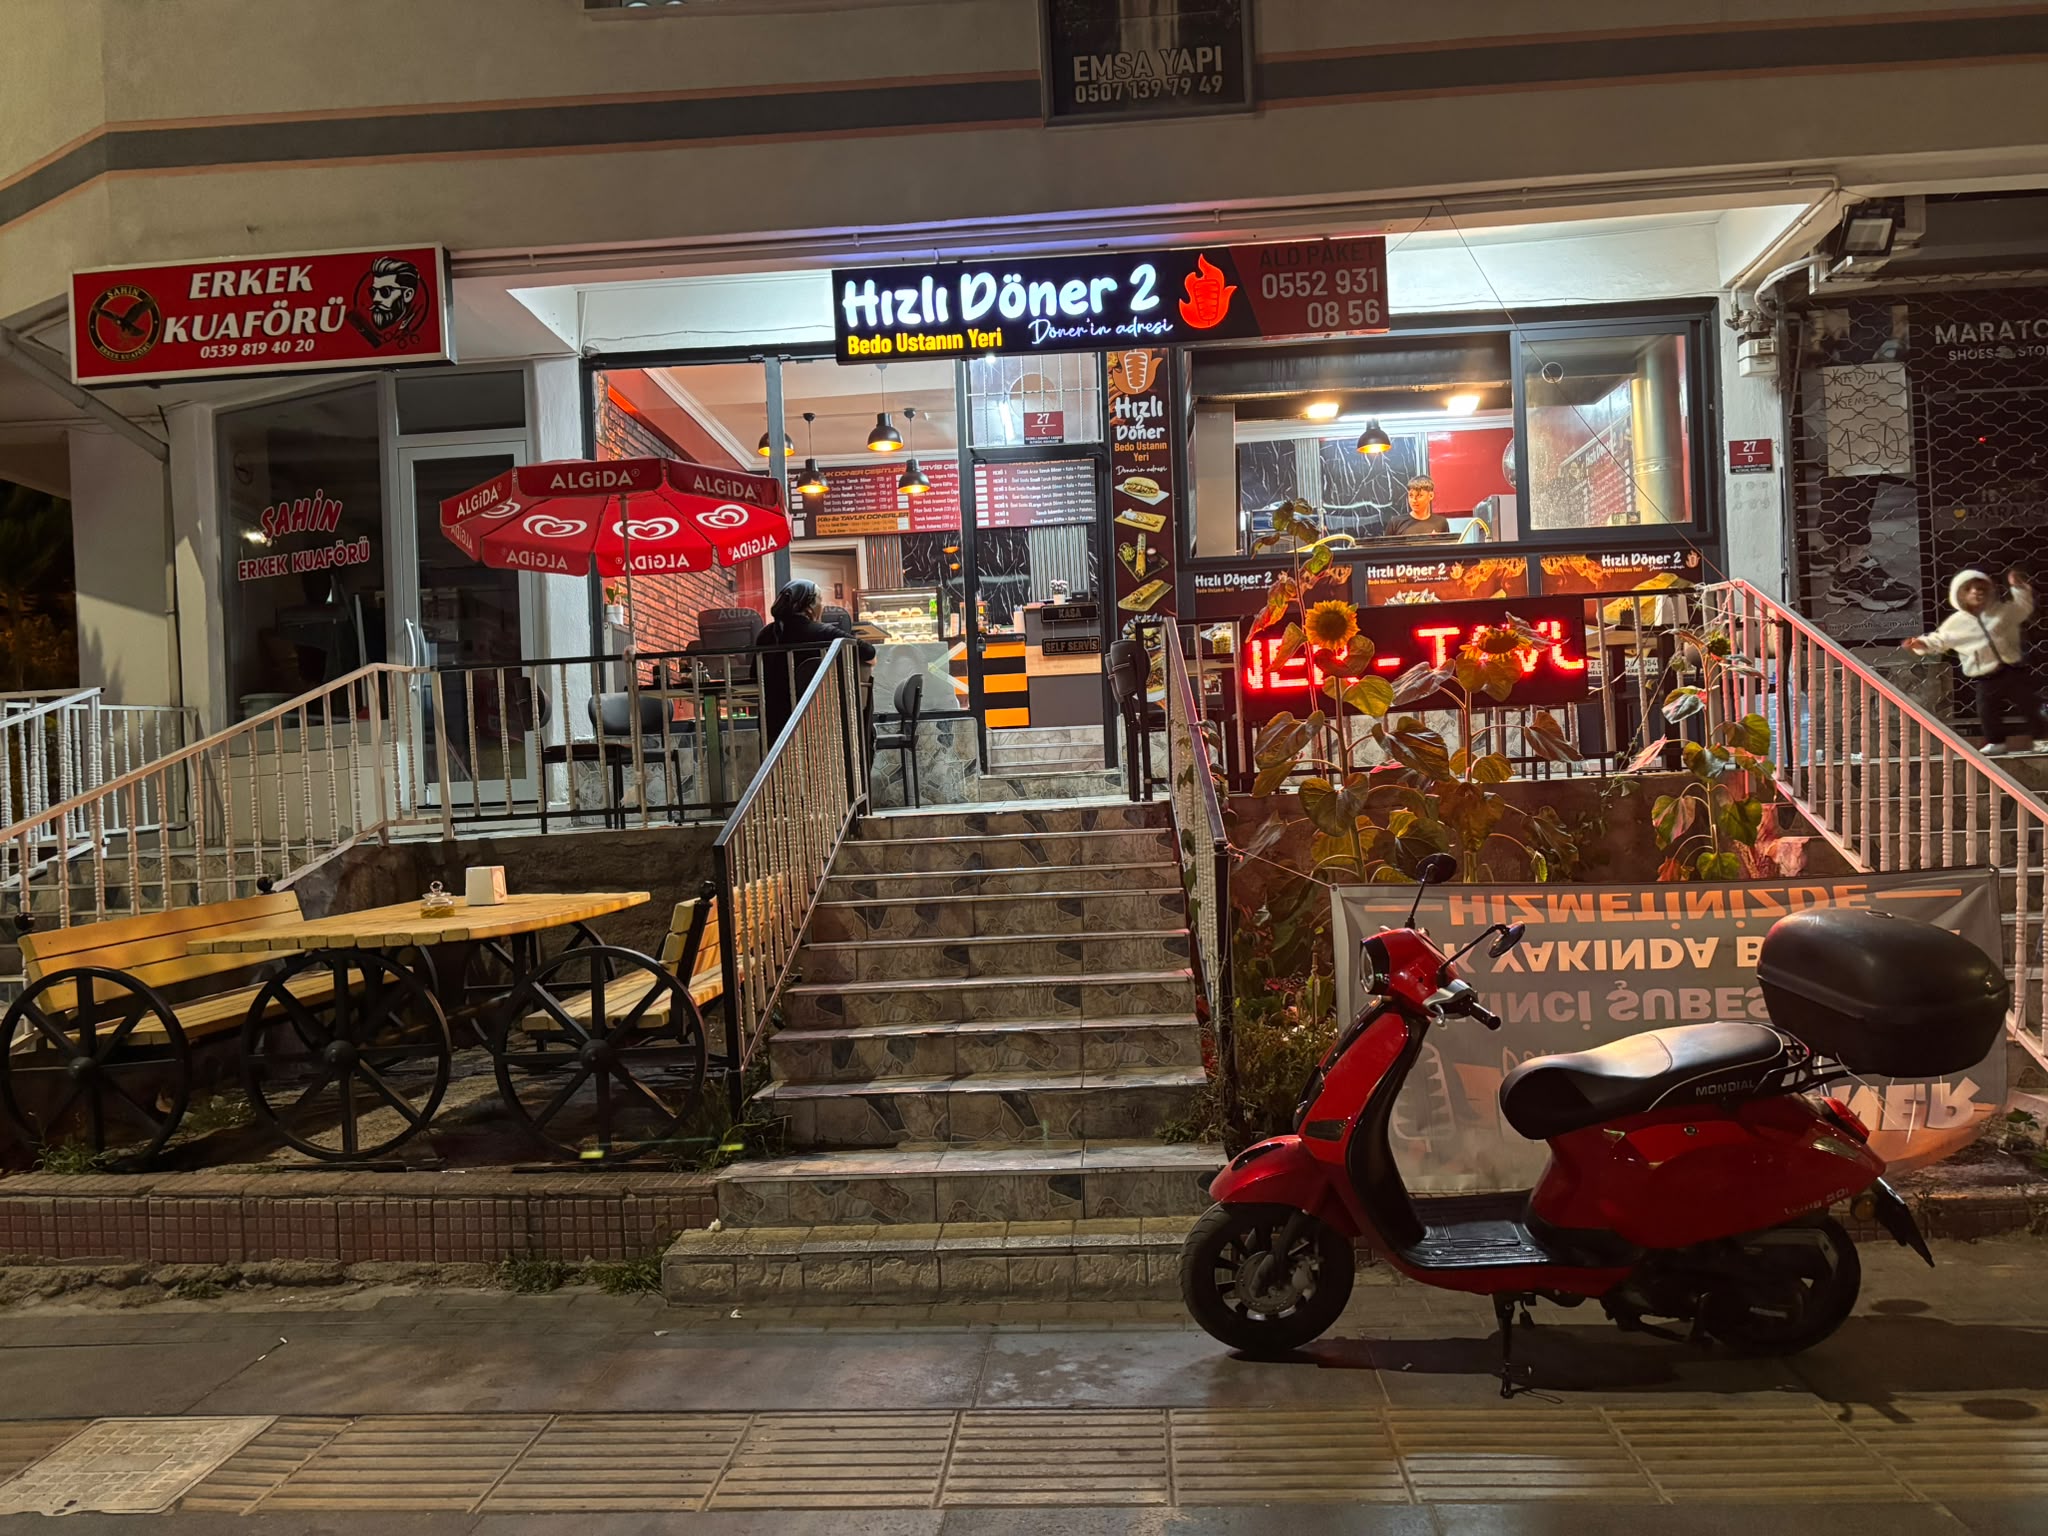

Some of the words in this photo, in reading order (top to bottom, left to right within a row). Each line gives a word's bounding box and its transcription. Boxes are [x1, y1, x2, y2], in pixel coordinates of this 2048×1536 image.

[1073, 51, 1154, 82] EMSA
[1160, 45, 1223, 75] YAPI
[1075, 82, 1123, 103] 0507
[1130, 79, 1161, 100] 139
[1169, 77, 1191, 96] 79
[1199, 75, 1223, 94] 49
[1307, 242, 1376, 264] PAKET
[189, 265, 313, 299] ERKEK
[1262, 270, 1328, 299] 0552
[1335, 267, 1378, 294] 931
[842, 275, 948, 328] Hızlı
[960, 271, 1118, 321] Döner
[1128, 263, 1160, 311] 2
[163, 296, 347, 343] KUAFÖRÜ
[1307, 301, 1340, 328] 08
[1347, 299, 1380, 325] 56
[1115, 316, 1174, 337] adresi
[200, 344, 237, 359] 0539
[241, 342, 268, 356] 819
[271, 340, 292, 354] 40
[294, 339, 315, 352] 20
[847, 333, 892, 355] Bedo
[896, 332, 963, 352] Ustanın
[967, 328, 1002, 349] Yeri
[1948, 348, 1994, 361] SHOES
[1115, 395, 1163, 419] Hızlı
[1037, 413, 1050, 424] 27
[1135, 414, 1145, 429] 2
[1116, 425, 1165, 441] Döner
[1114, 443, 1135, 452] Bedo
[1137, 442, 1168, 451] Ustanın
[1743, 441, 1757, 453] 27
[1133, 453, 1150, 462] Yeri
[1747, 455, 1754, 463] D
[238, 553, 288, 581] ERKEK
[292, 536, 370, 574] KUAFÖRÜ
[1602, 554, 1628, 567] Hızlı
[1631, 552, 1670, 565] Döner
[1673, 551, 1682, 563] 2
[1195, 574, 1221, 587] Hızlı
[1224, 572, 1256, 586] Döner
[1264, 571, 1272, 583] 2
[1367, 565, 1394, 578] Hızlı
[1396, 563, 1430, 577] Döner
[1437, 563, 1446, 575] 2
[1058, 606, 1081, 619] KASA
[1045, 641, 1066, 652] SELF
[1067, 637, 1099, 652] SERVİS
[1696, 1079, 1754, 1097] MONDIAL
